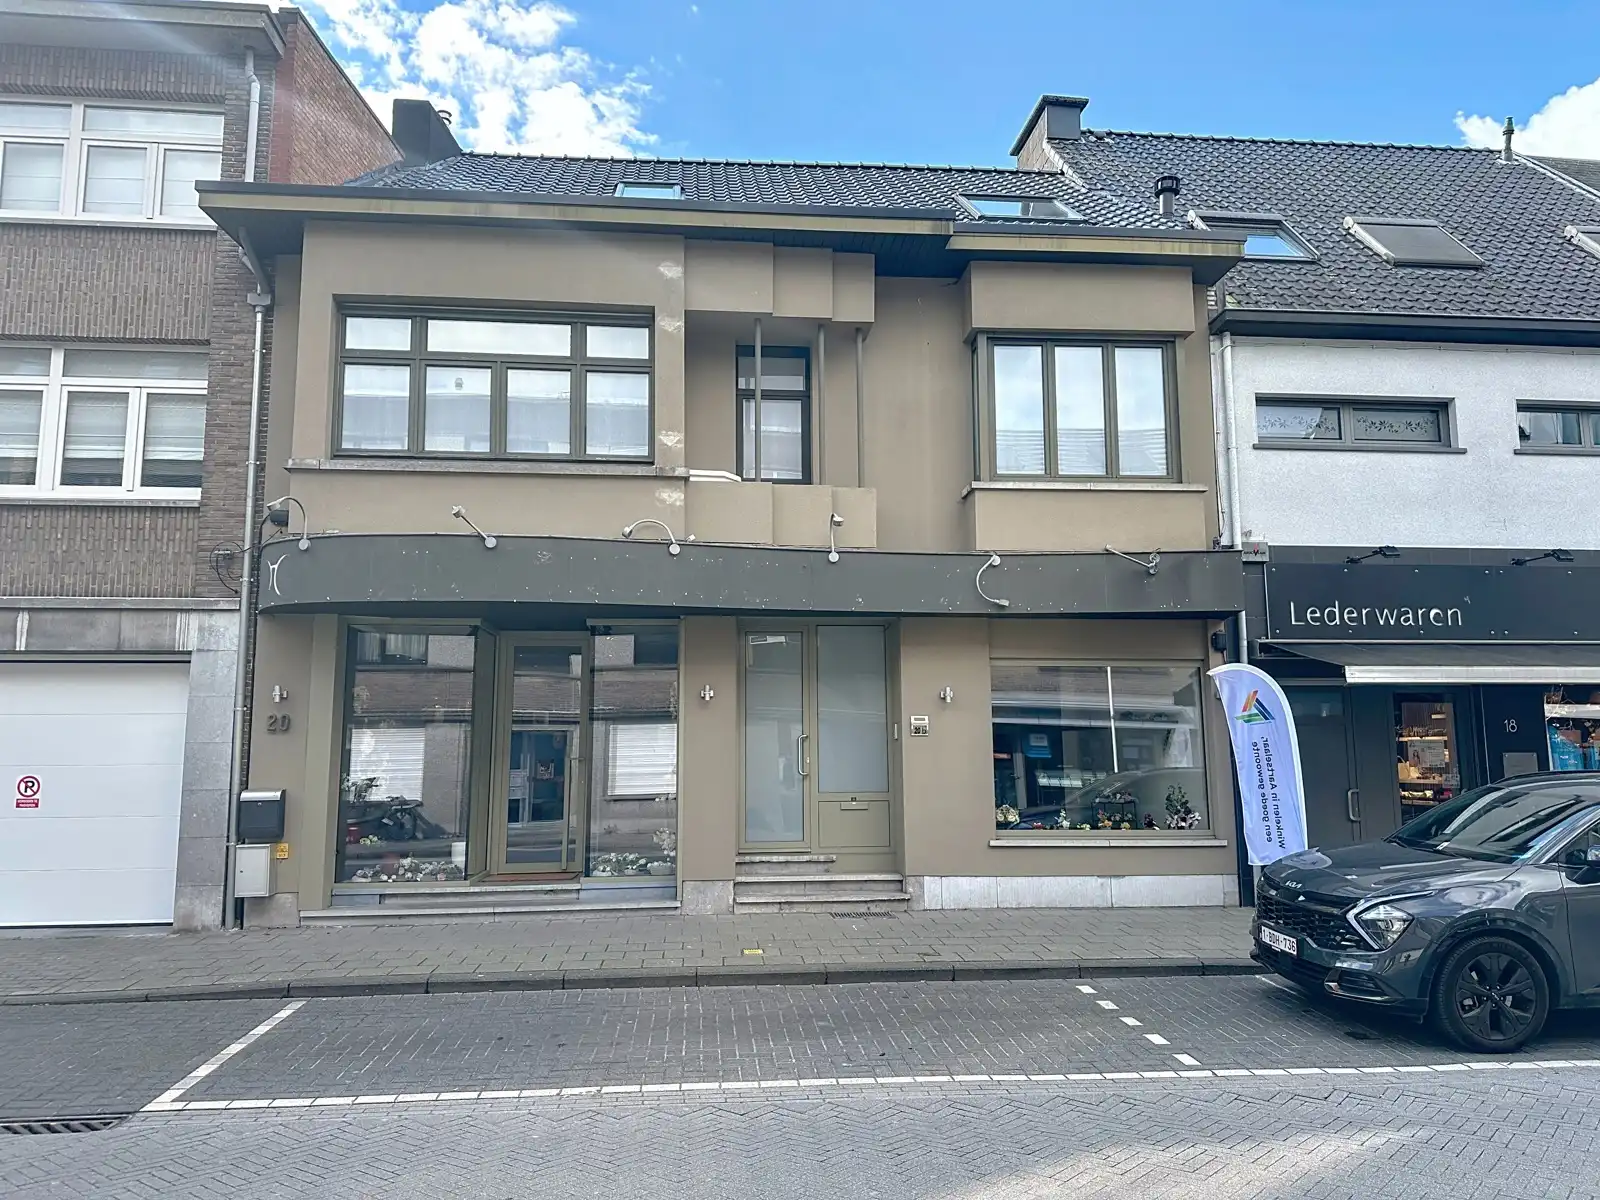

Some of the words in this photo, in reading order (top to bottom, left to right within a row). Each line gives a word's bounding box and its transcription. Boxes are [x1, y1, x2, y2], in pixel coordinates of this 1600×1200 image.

[1290, 600, 1462, 626] Lederwaren
[267, 713, 291, 733] 20
[1503, 719, 1518, 733] 18
